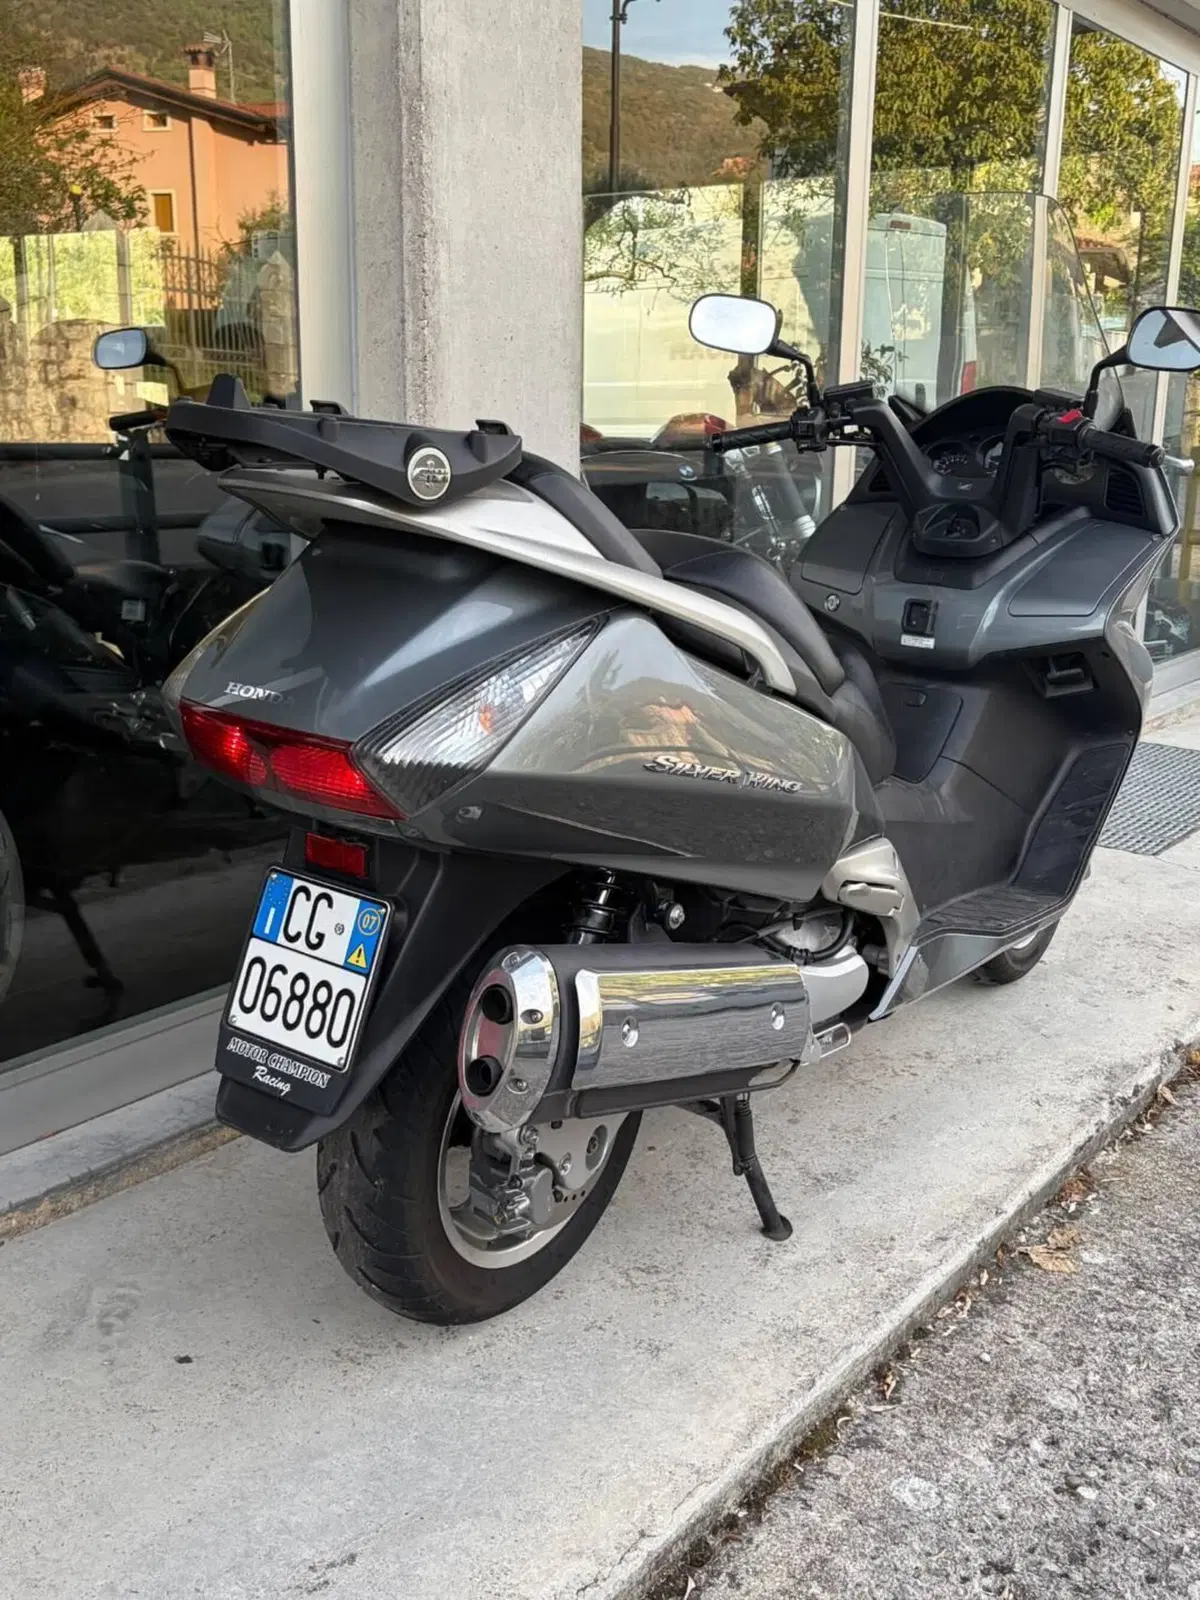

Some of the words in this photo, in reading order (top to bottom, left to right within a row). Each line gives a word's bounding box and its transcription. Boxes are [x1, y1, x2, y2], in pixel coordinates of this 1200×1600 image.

[643, 755, 741, 784] SILVER
[739, 768, 802, 794] WING
[263, 907, 277, 935] I
[283, 885, 334, 951] CG
[362, 914, 377, 930] 07
[238, 956, 356, 1049] 06880
[226, 1037, 269, 1064] MOTOR
[267, 1053, 332, 1089] CHAMPION
[252, 1065, 292, 1096] Racing
